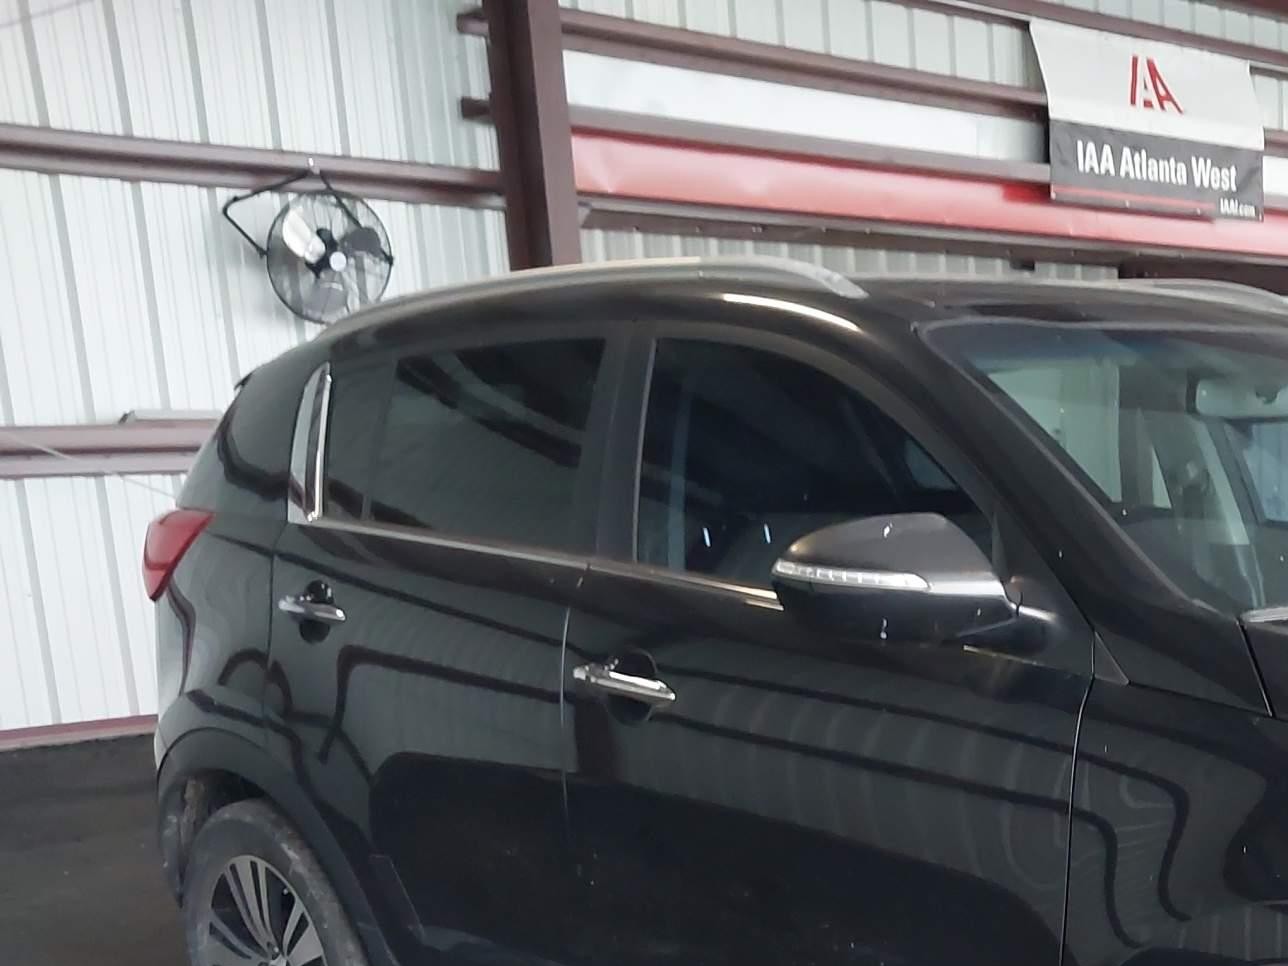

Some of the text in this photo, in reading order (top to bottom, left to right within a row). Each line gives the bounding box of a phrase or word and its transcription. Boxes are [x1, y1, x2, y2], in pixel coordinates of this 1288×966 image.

[1077, 139, 1238, 193] IAA Atlanta West
